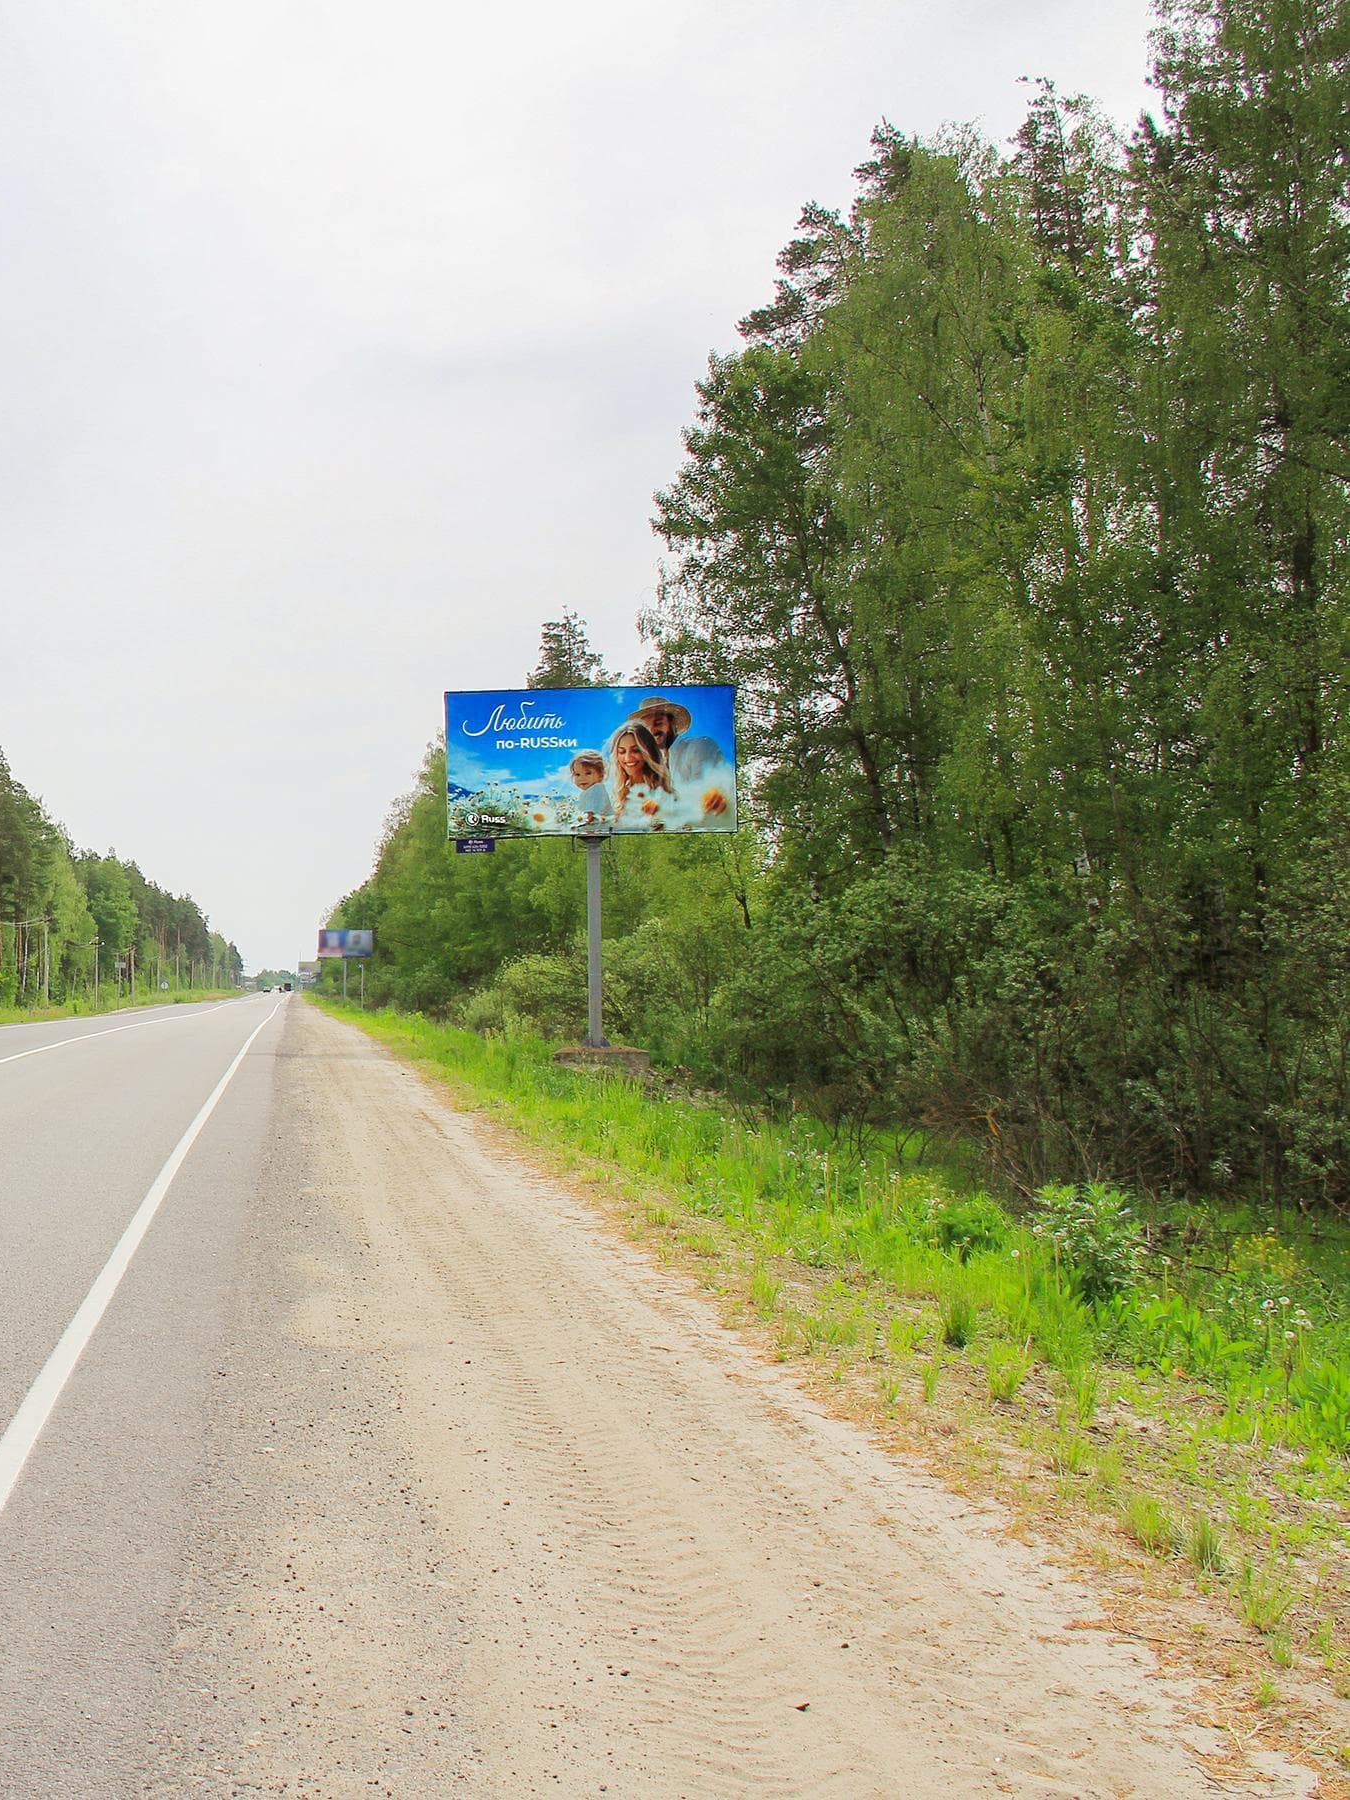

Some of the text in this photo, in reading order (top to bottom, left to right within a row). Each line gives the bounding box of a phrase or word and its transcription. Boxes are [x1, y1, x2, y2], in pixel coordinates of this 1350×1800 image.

[462, 701, 566, 737] Любить
[496, 737, 577, 749] по-RUSSки
[481, 814, 506, 824] Russ
